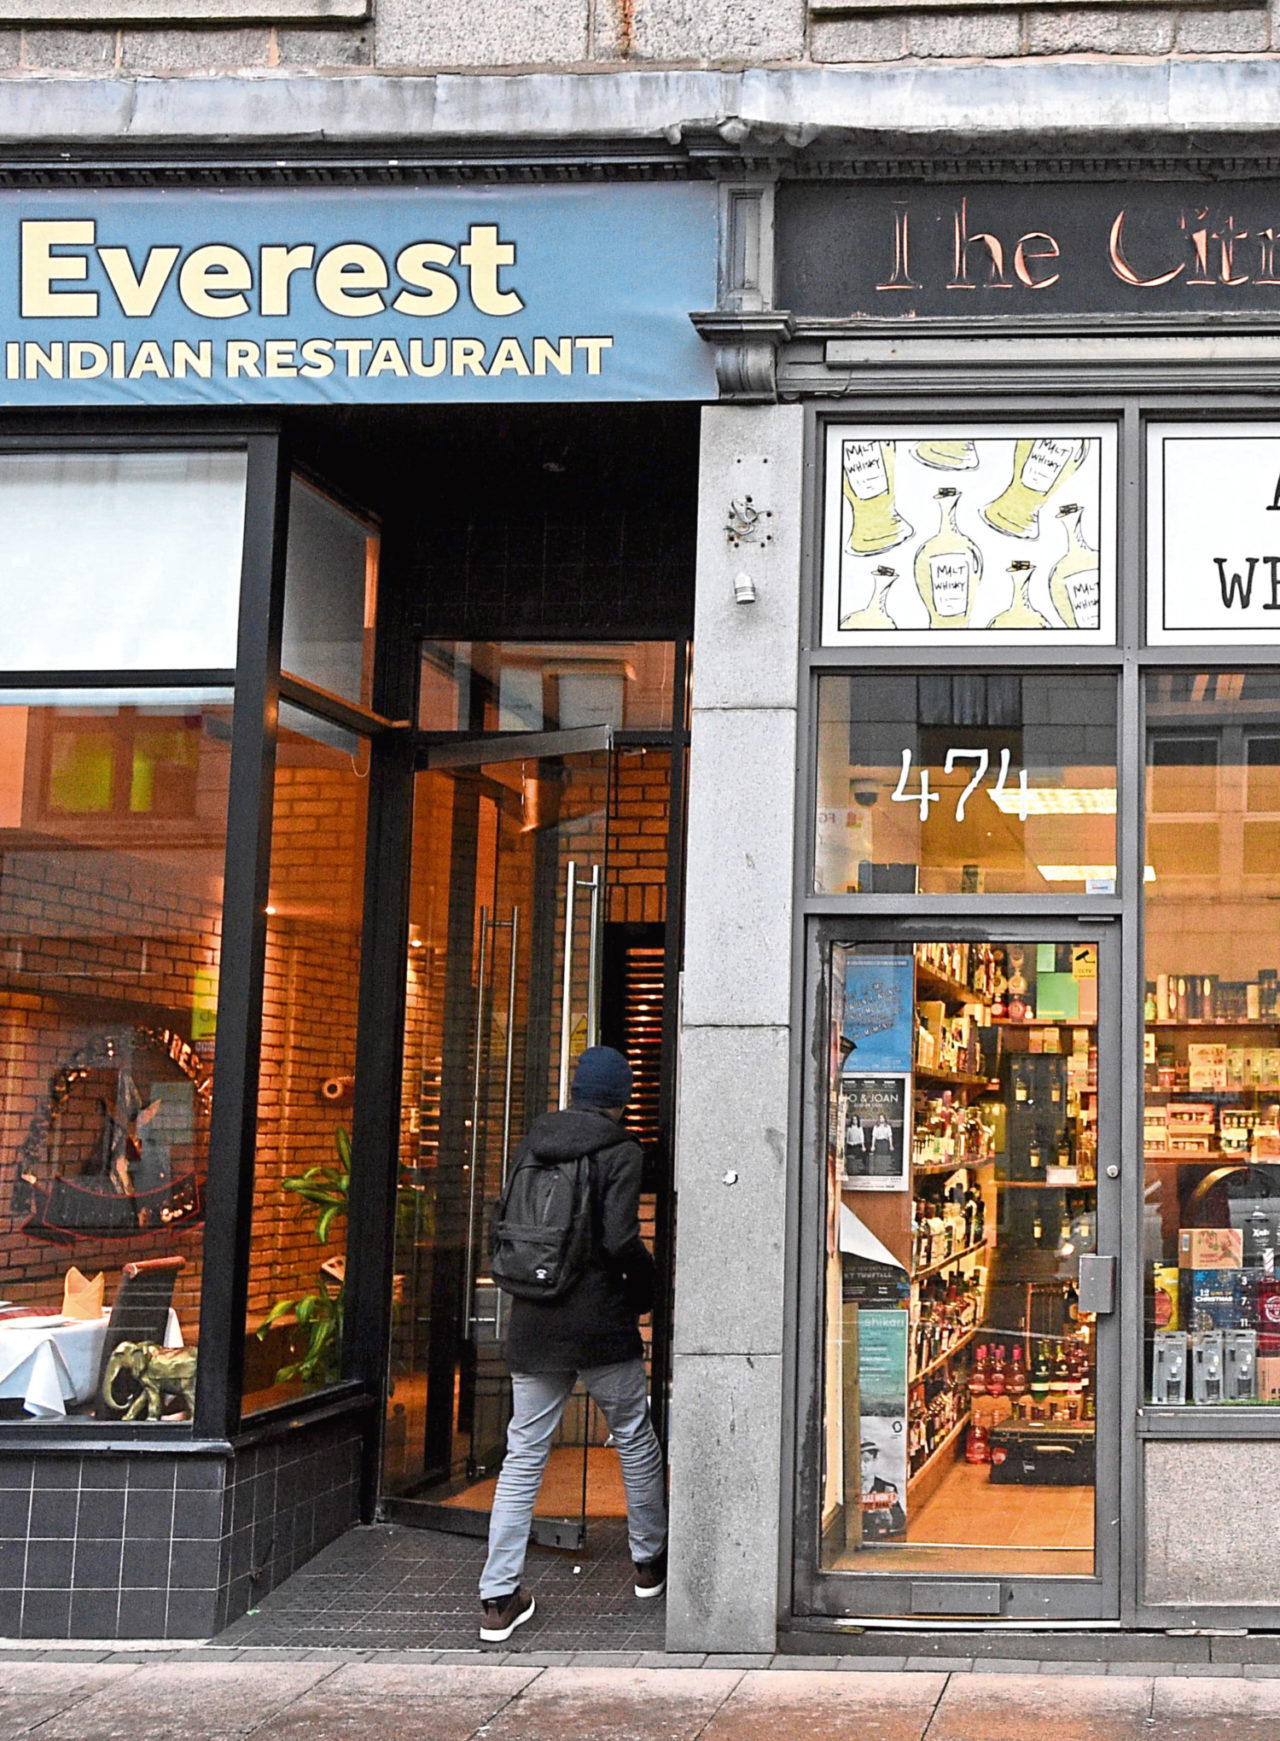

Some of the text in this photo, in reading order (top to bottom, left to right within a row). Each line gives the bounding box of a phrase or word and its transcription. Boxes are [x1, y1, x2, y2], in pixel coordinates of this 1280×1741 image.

[874, 196, 1060, 291] The
[20, 218, 524, 317] Everest
[5, 336, 614, 381] INDIAN RESTAURANT
[846, 440, 876, 460] MALT
[936, 565, 966, 578] MALT
[934, 581, 966, 592] WHISKY
[891, 748, 1027, 822] 474
[871, 1094, 899, 1103] JOAN
[1241, 1297, 1247, 1306] 7
